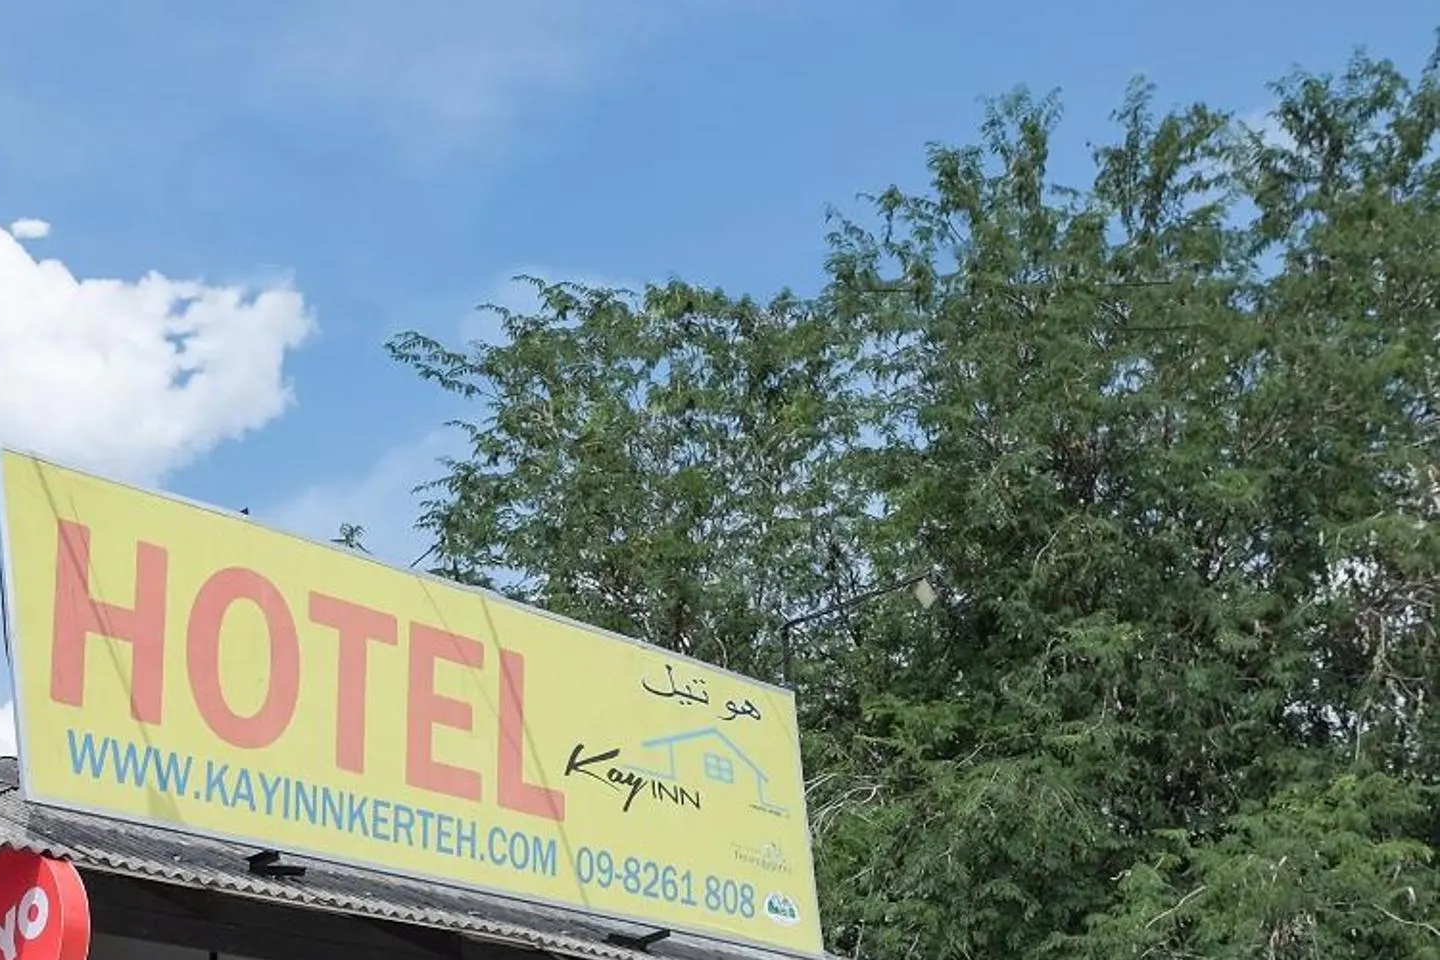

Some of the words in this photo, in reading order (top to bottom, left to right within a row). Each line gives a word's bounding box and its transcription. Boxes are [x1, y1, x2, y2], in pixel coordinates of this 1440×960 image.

[50, 518, 565, 821] HOTEL
[66, 729, 558, 877] WWW.KAYINNKERTEH.COM
[705, 875, 756, 919] 808
